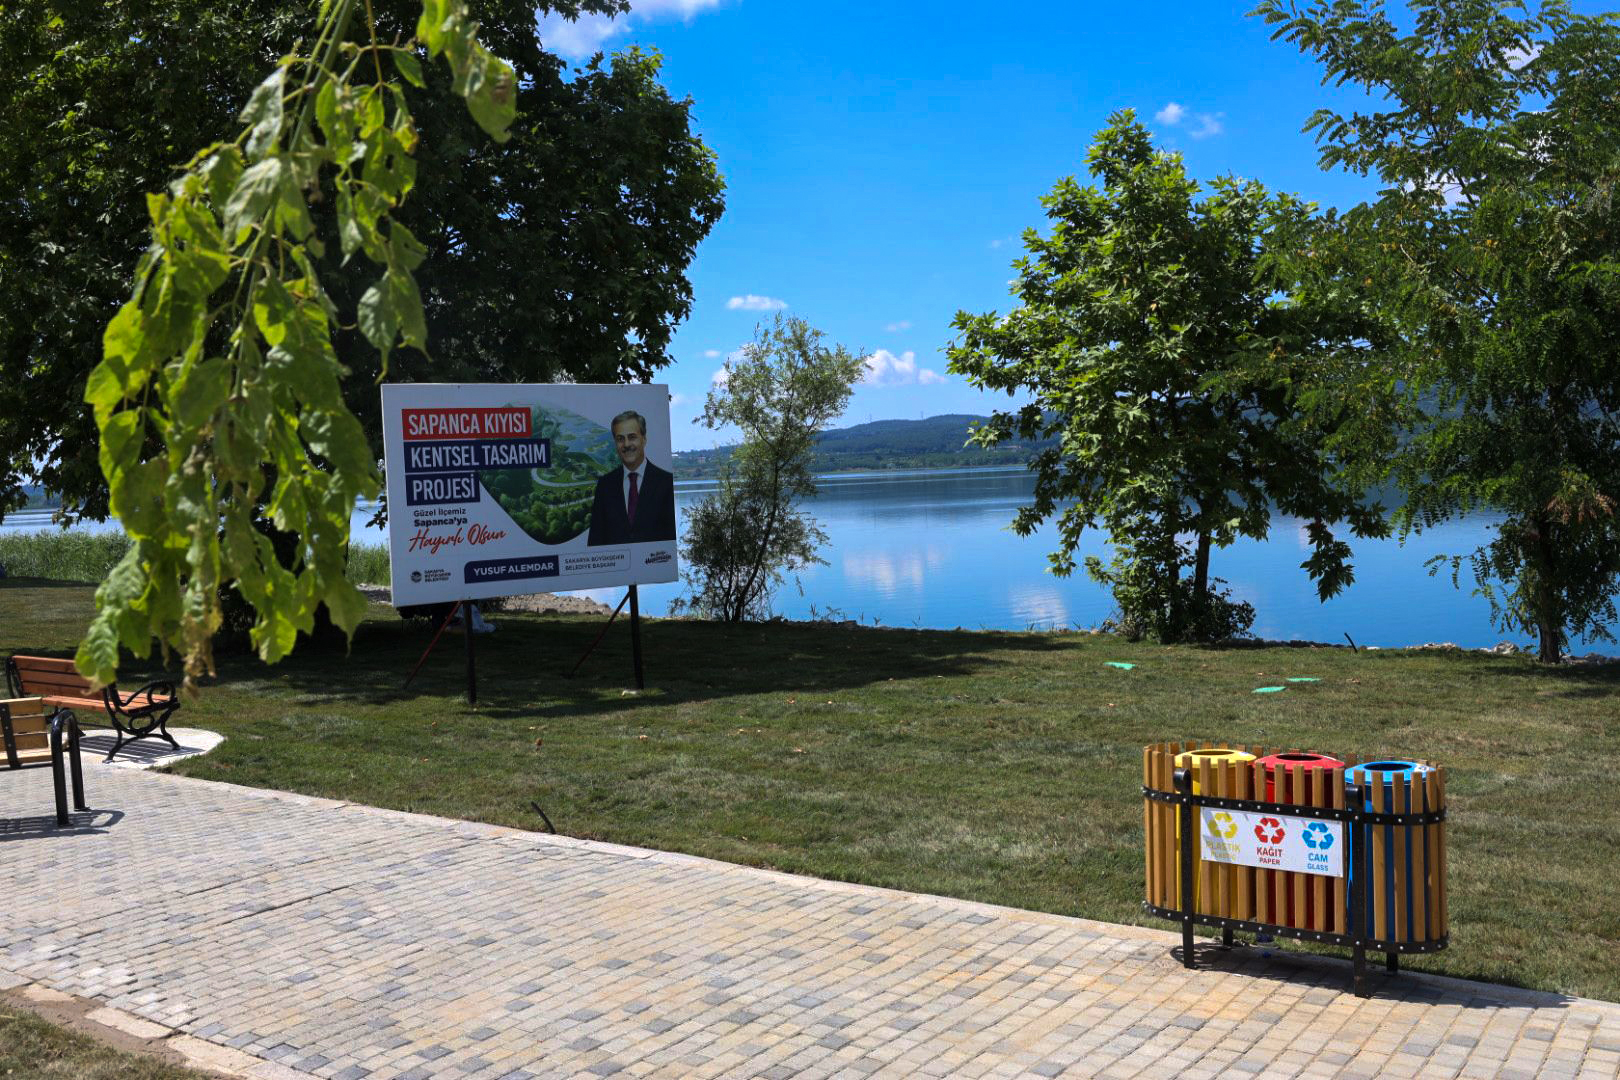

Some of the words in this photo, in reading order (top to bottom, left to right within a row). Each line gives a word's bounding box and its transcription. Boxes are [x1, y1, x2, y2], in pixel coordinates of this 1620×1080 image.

[408, 413, 480, 435] SAPANCA
[484, 412, 527, 433] KIYISI
[411, 445, 479, 468] KENTSEL
[482, 443, 546, 465] TASARIM
[412, 474, 476, 501] PROJESİ
[413, 508, 436, 517] Güzel
[438, 507, 466, 517] İlçemiz
[414, 517, 468, 528] Sapanca'ya
[408, 527, 465, 555] Hayırlı
[467, 523, 507, 545] Olsun
[473, 566, 507, 577] YUSUF
[507, 562, 554, 574] ALEMDAR
[1256, 846, 1283, 857] KAĞIT
[1259, 857, 1281, 865] PAPER
[1308, 852, 1328, 863] CAM
[1307, 863, 1329, 871] GLASS
